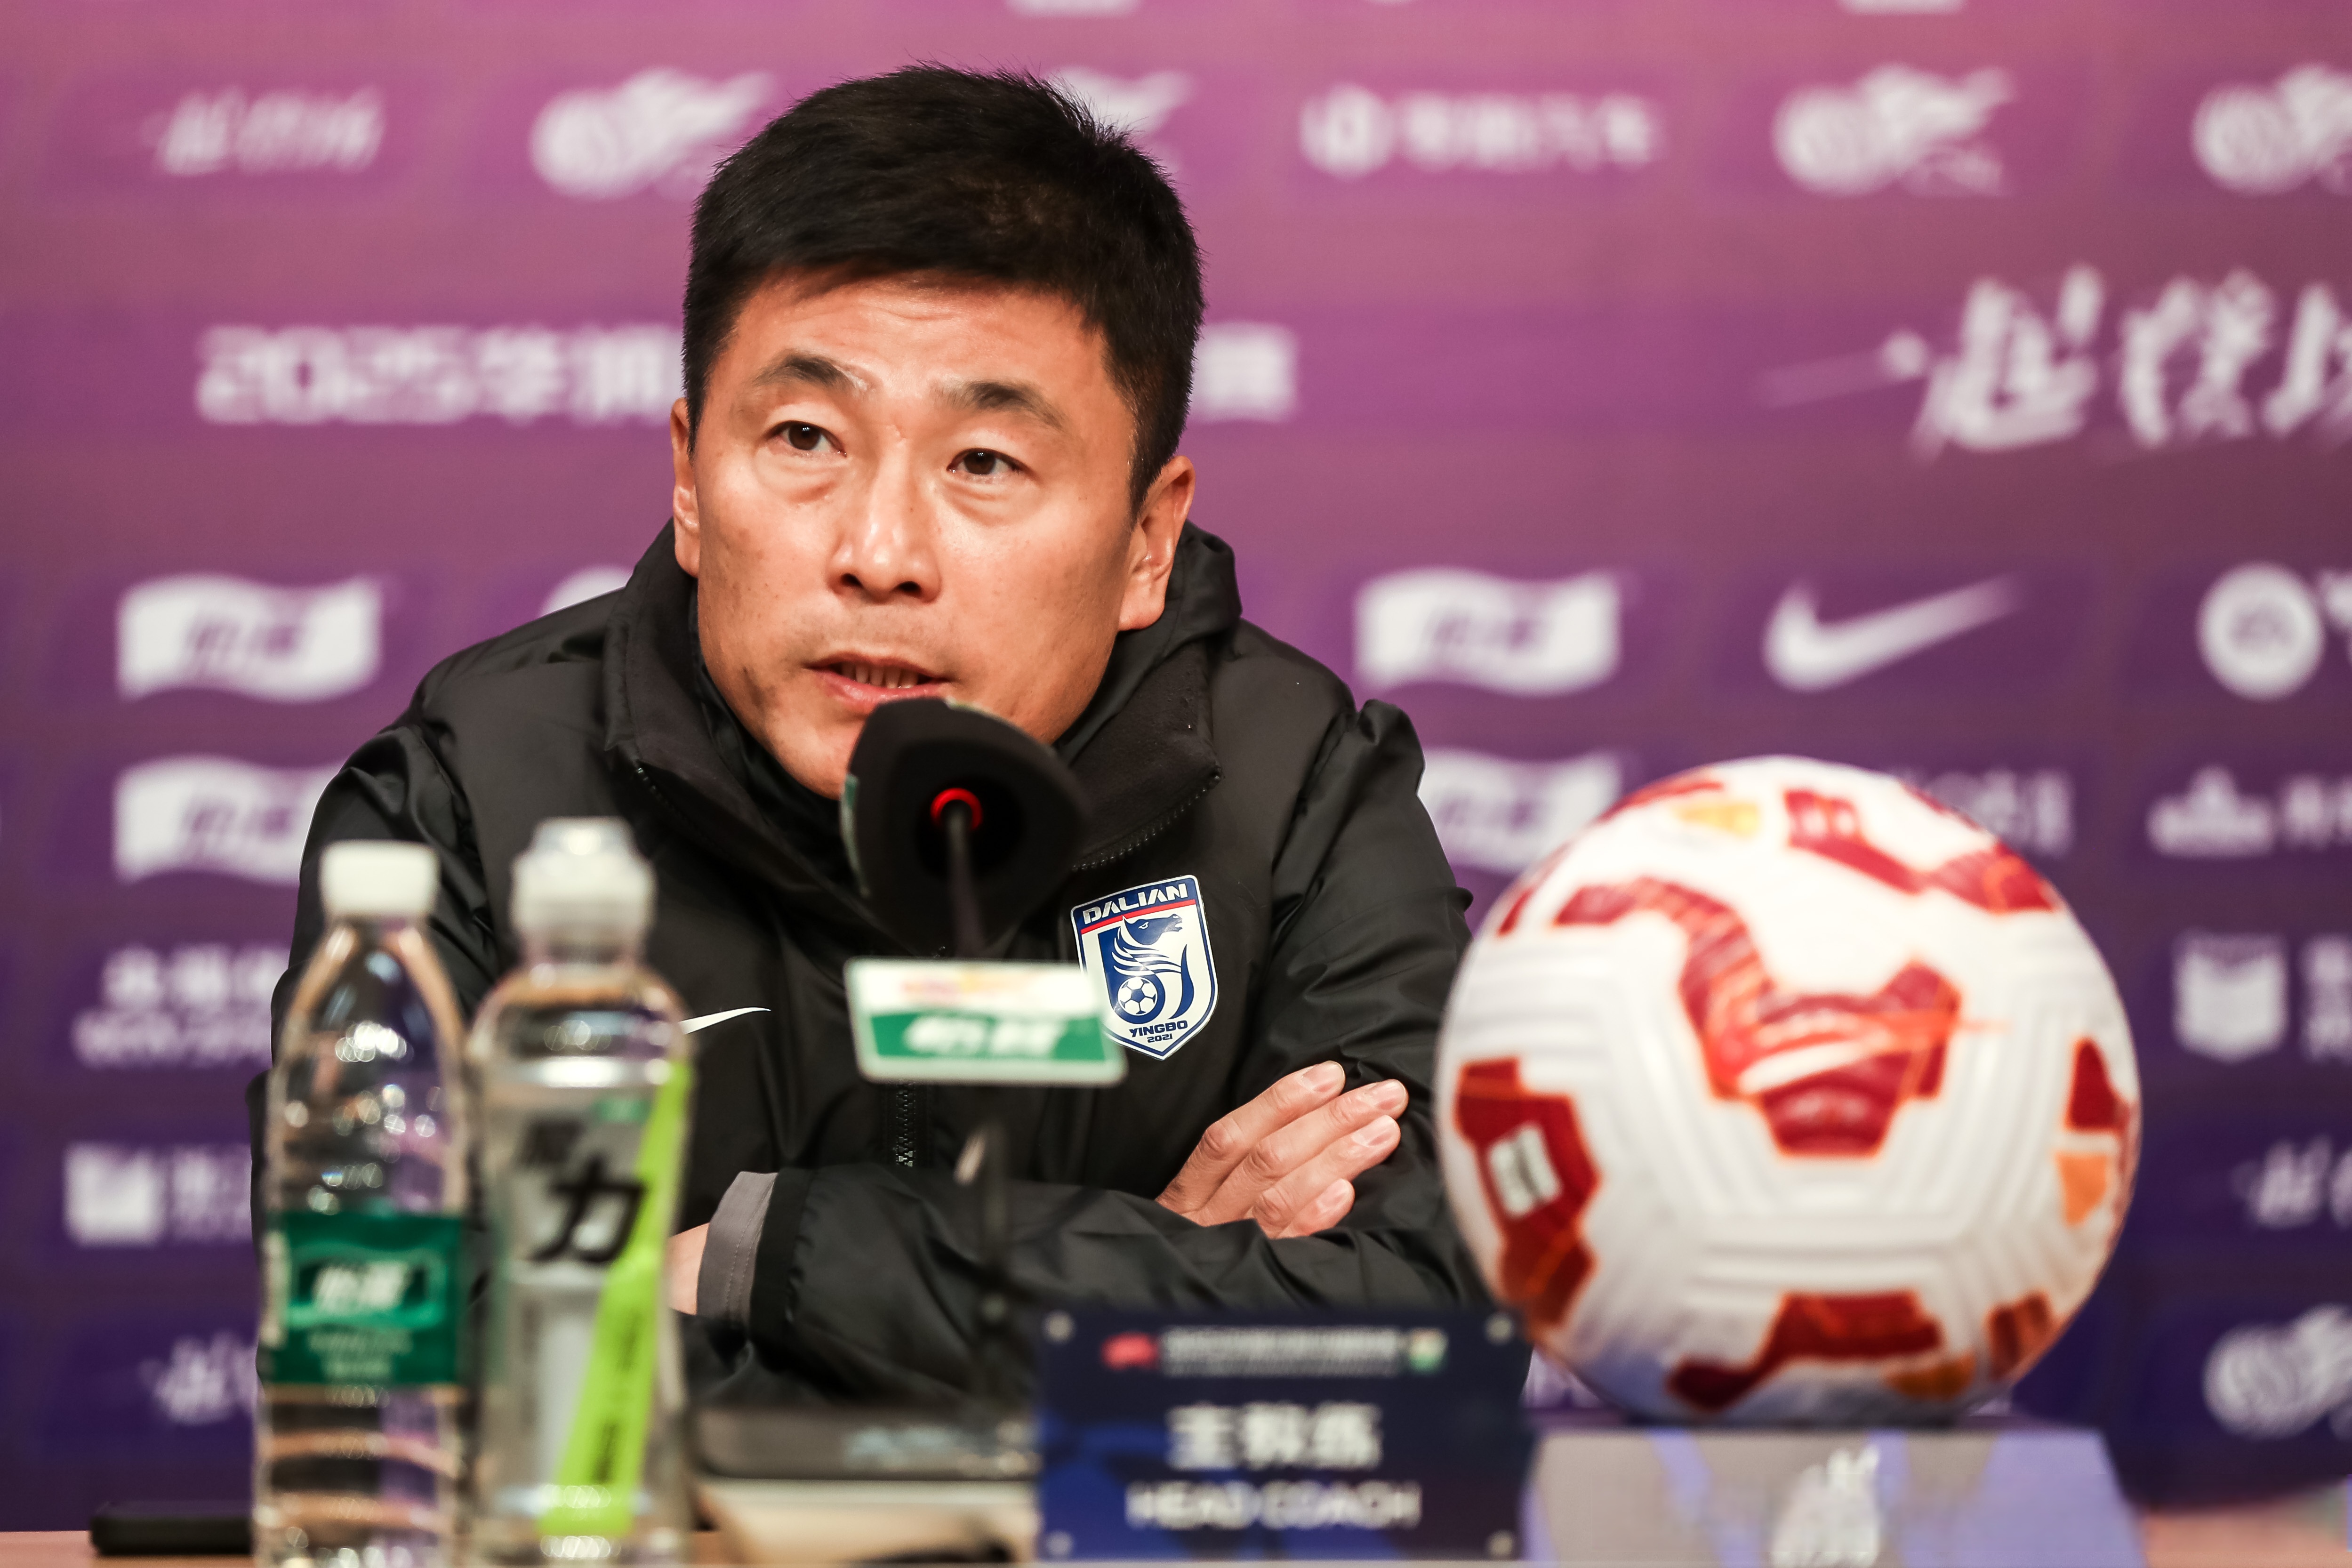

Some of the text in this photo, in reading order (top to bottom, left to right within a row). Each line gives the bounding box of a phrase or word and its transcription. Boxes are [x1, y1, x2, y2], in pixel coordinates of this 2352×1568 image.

[1083, 883, 1188, 925] DALIAN
[1129, 1020, 1188, 1037] YINGBO
[1147, 1034, 1173, 1043] 2021
[1166, 1400, 1383, 1472] 主教练
[1125, 1479, 1422, 1530] HEAD COACH
